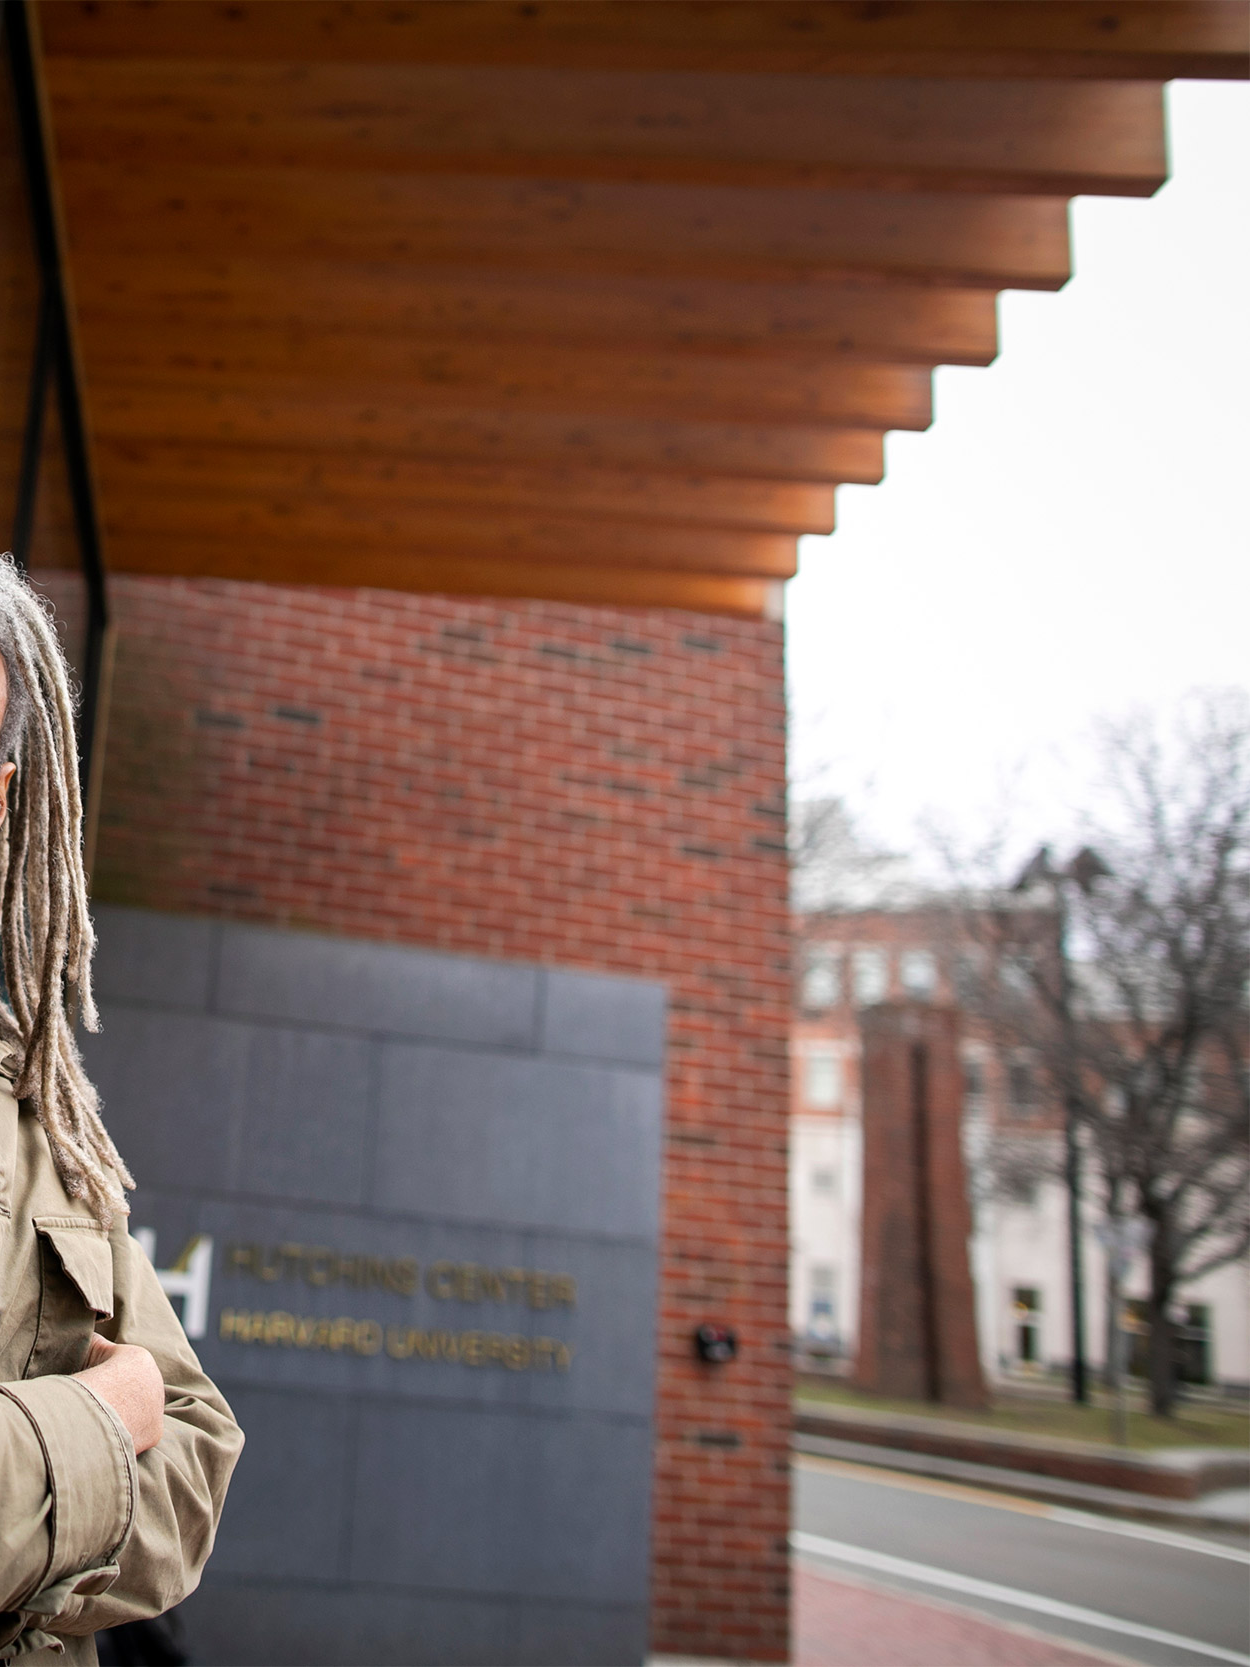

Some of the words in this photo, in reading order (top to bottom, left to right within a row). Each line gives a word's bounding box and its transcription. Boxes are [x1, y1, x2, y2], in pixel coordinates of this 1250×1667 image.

[425, 1259, 578, 1309] CENTER
[219, 1307, 383, 1356] HARVARD
[385, 1325, 573, 1373] UNIVERSITY
